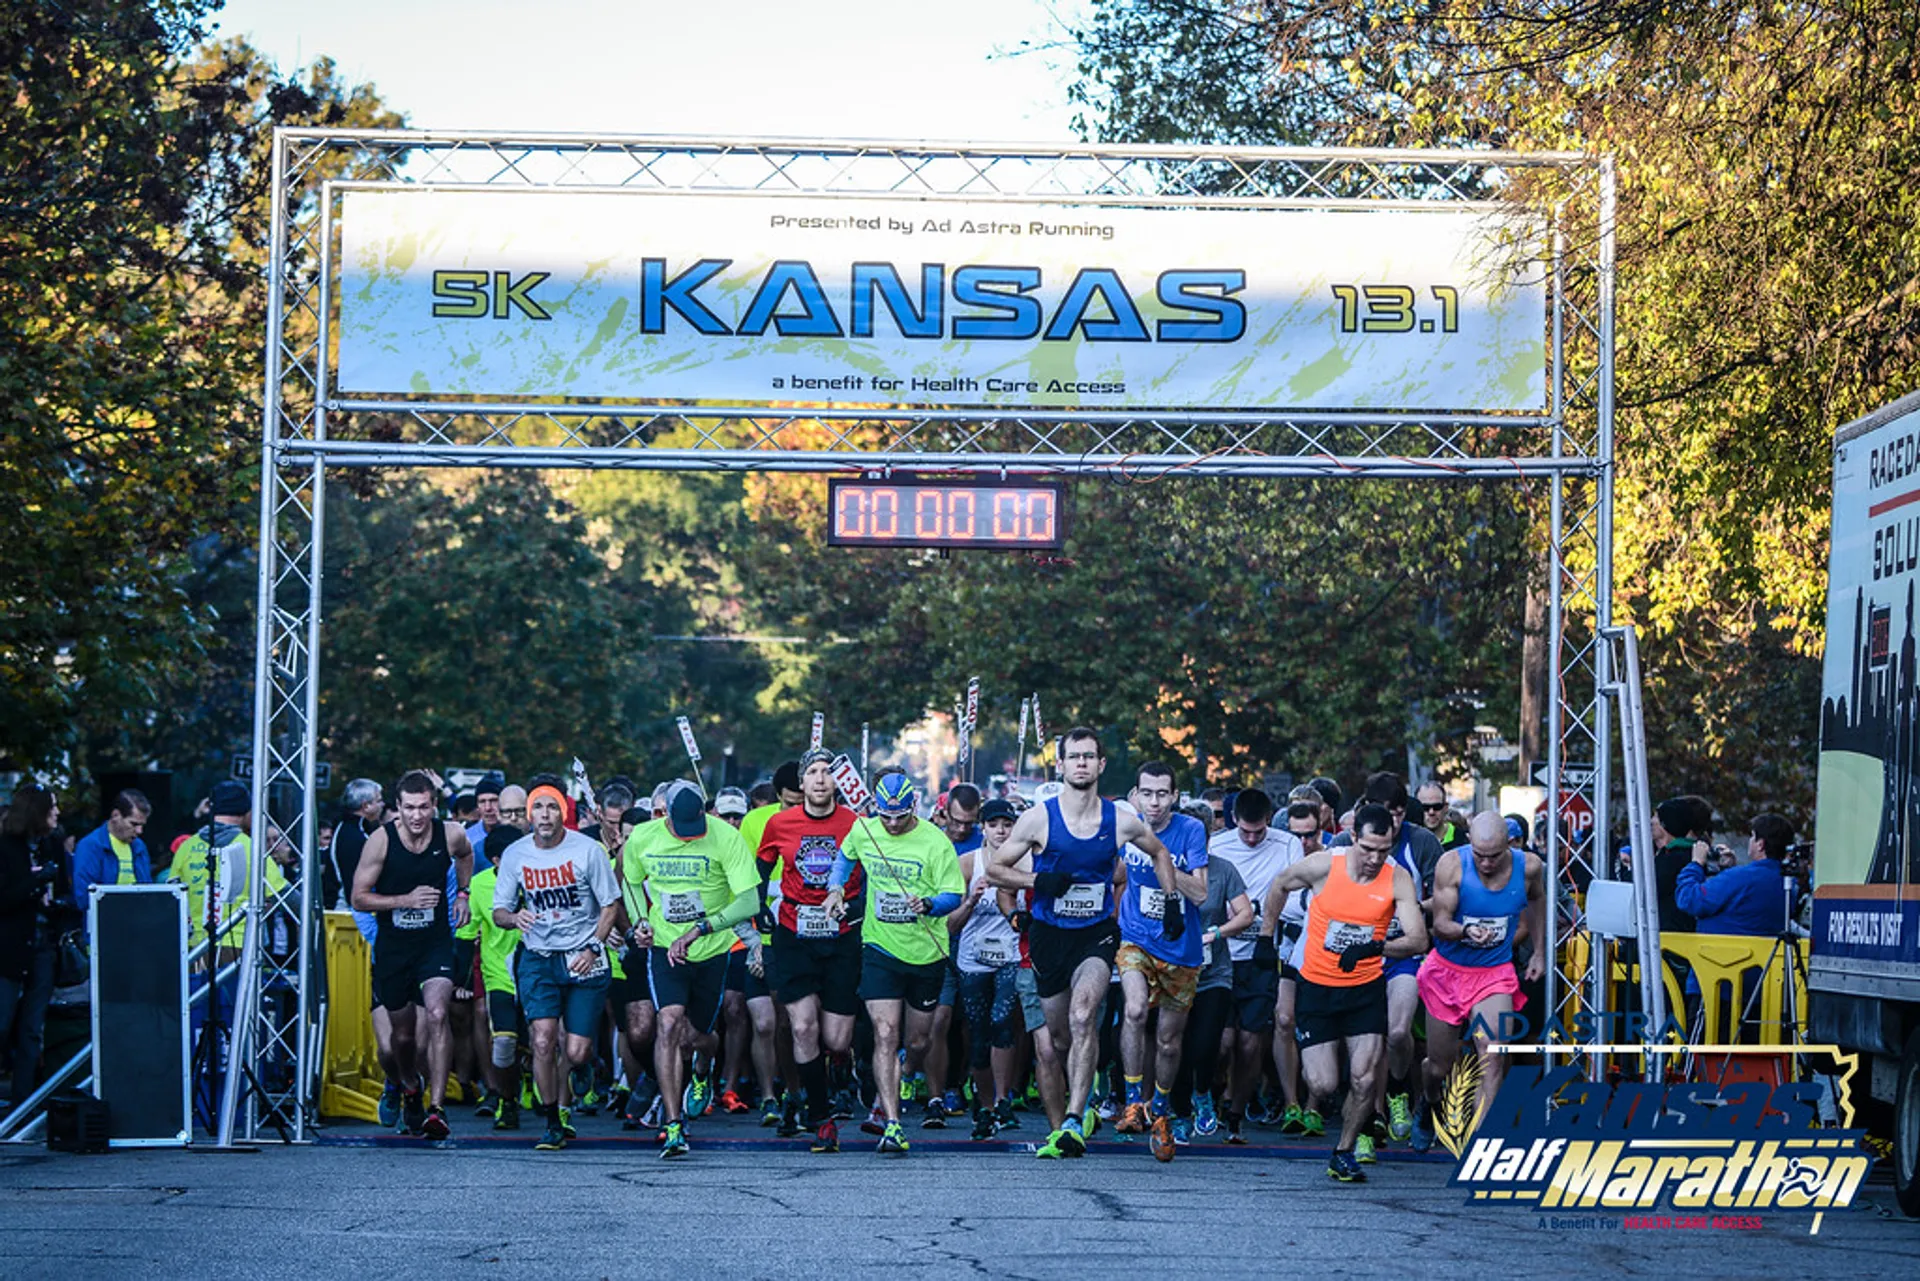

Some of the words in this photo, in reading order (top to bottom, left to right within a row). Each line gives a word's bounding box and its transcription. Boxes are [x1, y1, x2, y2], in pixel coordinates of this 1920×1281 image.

[770, 215, 881, 230] Presented
[888, 217, 913, 235] by
[921, 218, 952, 233] Ad
[959, 220, 1021, 234] Astra
[1029, 221, 1114, 240] Running
[432, 270, 552, 320] 5K
[639, 256, 1247, 343] KANSAS
[1331, 284, 1459, 333] 13.1
[772, 377, 785, 389] a
[791, 375, 864, 390] benefit
[871, 376, 904, 391] for
[911, 377, 979, 392] Health
[986, 378, 1038, 393] Care
[1045, 379, 1126, 394] Access
[836, 765, 867, 805] 1:35
[522, 860, 577, 890] BURN
[527, 885, 582, 911] MODE
[1064, 900, 1095, 909] 1130
[1828, 911, 1844, 943] FOR
[1845, 911, 1879, 946] RESULTS
[1881, 912, 1903, 947] VISIT
